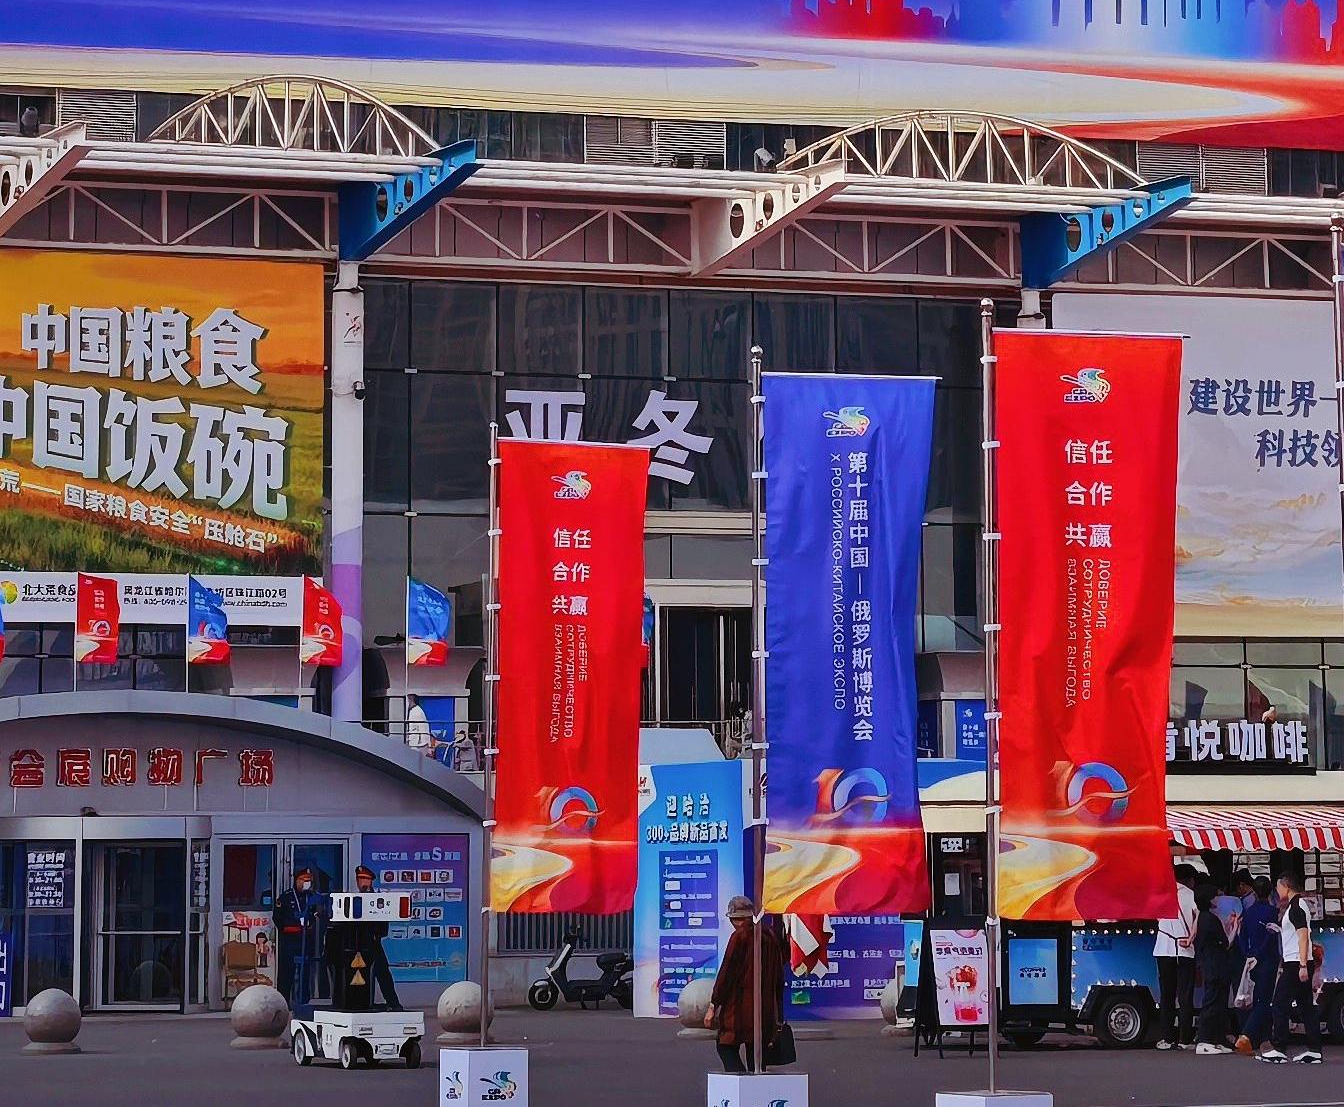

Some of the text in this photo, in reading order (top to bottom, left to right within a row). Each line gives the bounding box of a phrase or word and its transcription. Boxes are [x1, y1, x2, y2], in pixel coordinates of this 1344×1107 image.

[20, 303, 269, 395] 中国粮食
[1064, 438, 1113, 465] 信任
[1064, 480, 1113, 507] 合作
[553, 527, 592, 549] 信任
[1064, 523, 1112, 549] 共赢
[552, 562, 591, 583] 合作
[552, 595, 588, 616] 共赢
[1095, 559, 1112, 629] ДОВЕРИЕ
[834, 659, 846, 710] ЭКСПО
